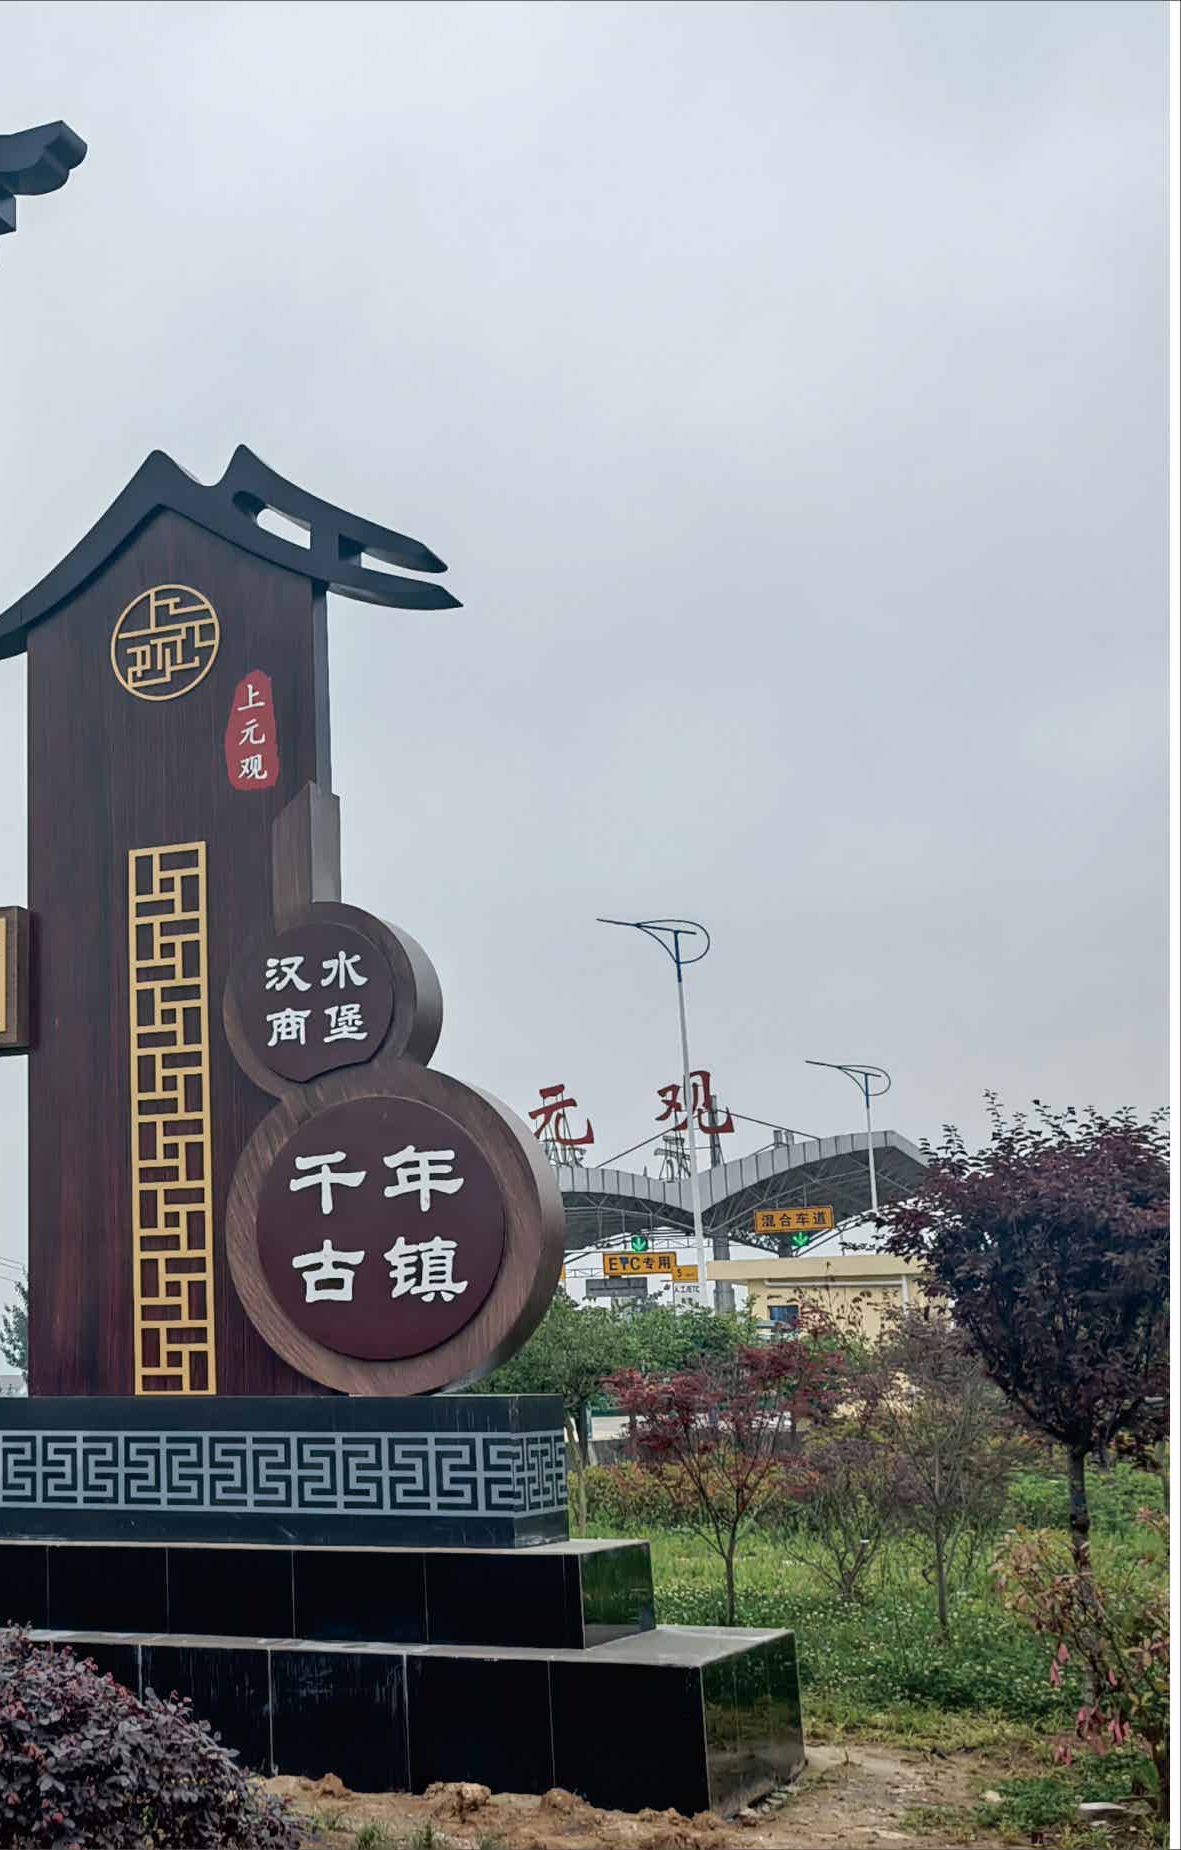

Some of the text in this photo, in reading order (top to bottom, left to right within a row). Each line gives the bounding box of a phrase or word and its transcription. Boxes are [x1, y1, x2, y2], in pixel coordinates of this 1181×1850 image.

[237, 684, 268, 780] 上元观
[265, 950, 368, 992] 汉水
[266, 1003, 368, 1047] 商堡
[289, 1144, 465, 1215] 千年
[761, 1211, 826, 1227] 混合车道
[292, 1236, 468, 1303] 古镇
[608, 1255, 671, 1271] ETC专用
